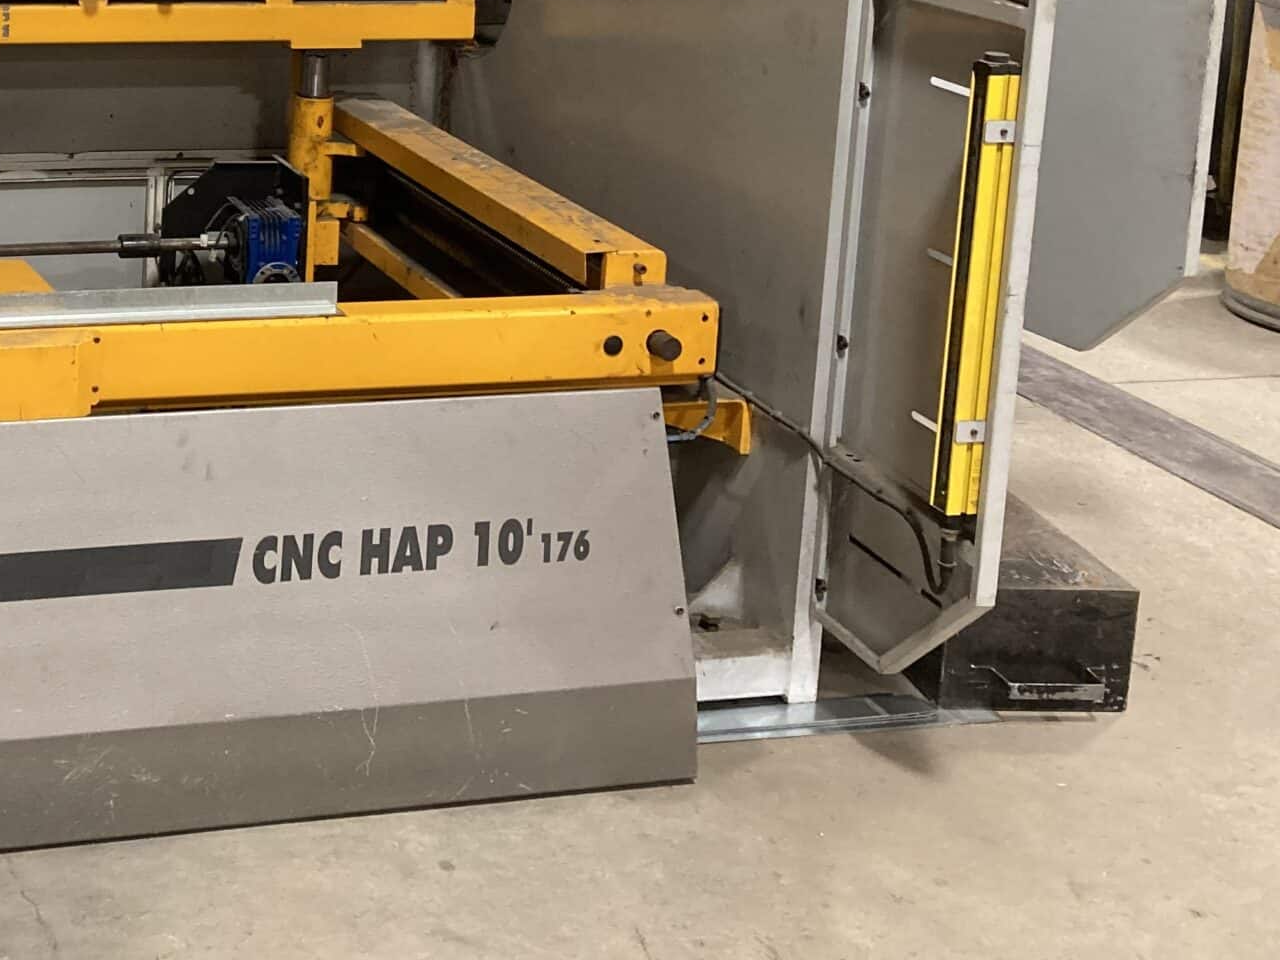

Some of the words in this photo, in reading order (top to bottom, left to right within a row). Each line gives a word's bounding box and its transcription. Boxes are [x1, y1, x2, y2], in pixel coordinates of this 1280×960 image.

[252, 530, 344, 584] CNC
[359, 524, 454, 576] HAP
[541, 529, 591, 564] 176
